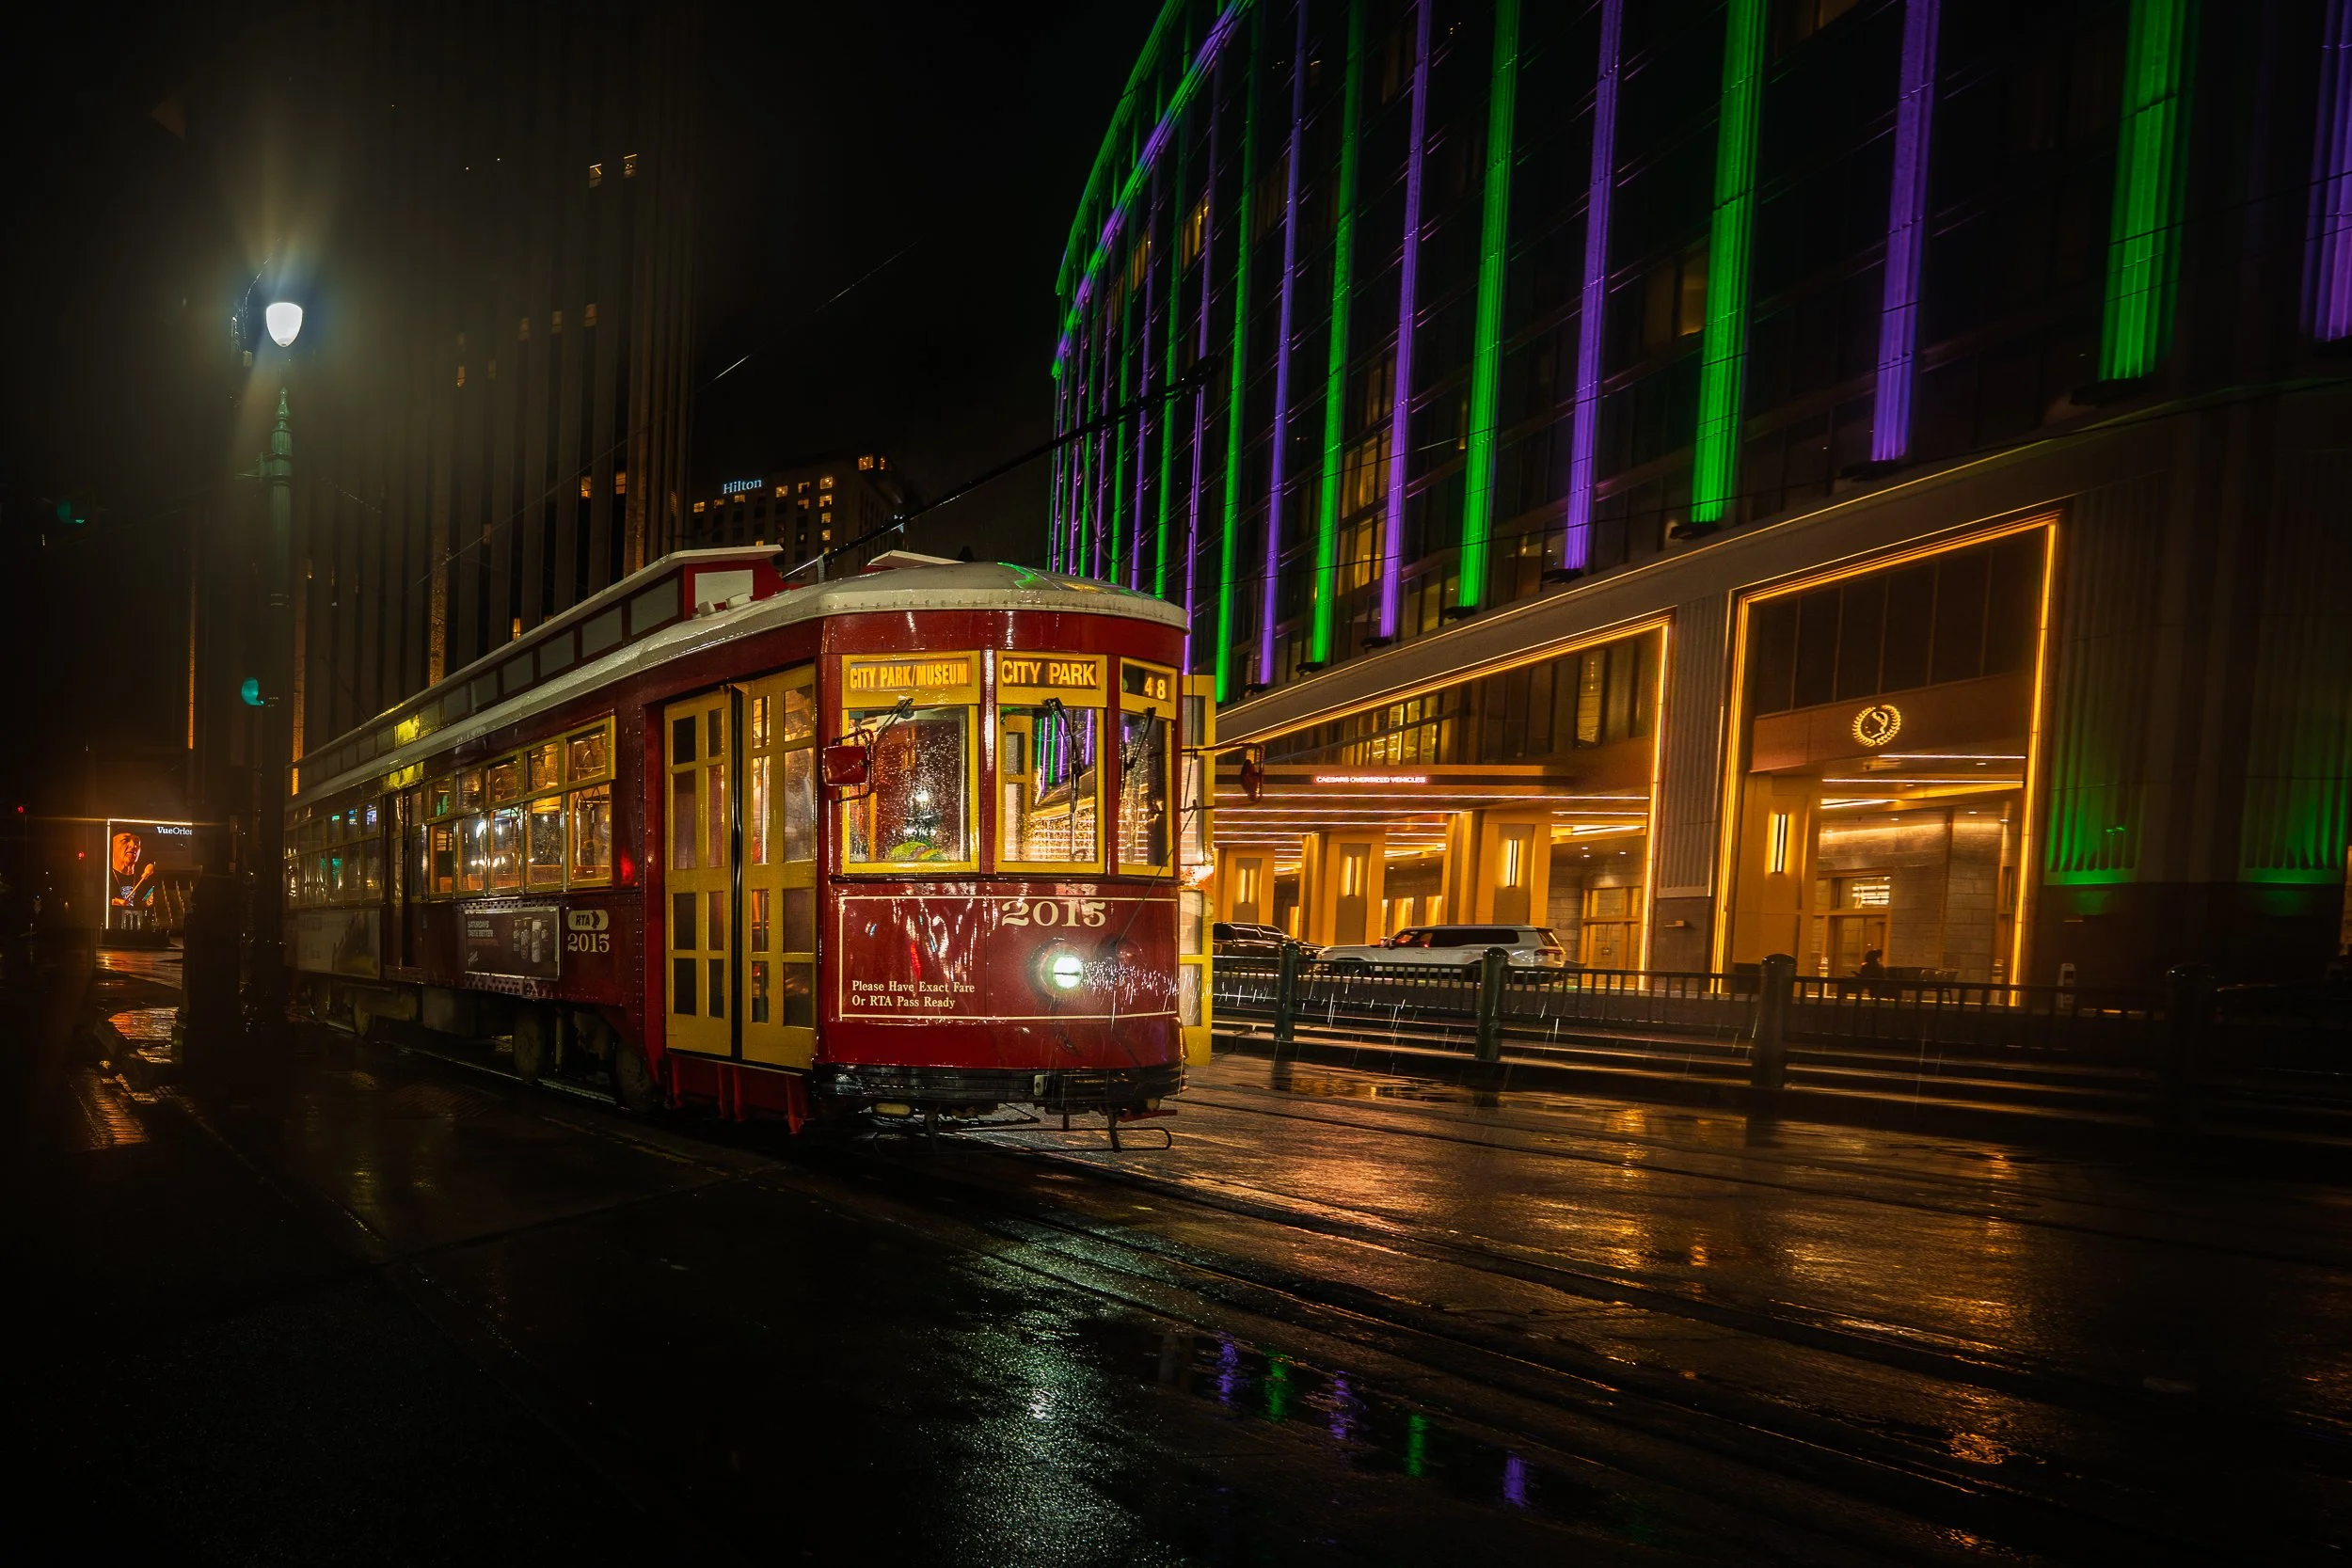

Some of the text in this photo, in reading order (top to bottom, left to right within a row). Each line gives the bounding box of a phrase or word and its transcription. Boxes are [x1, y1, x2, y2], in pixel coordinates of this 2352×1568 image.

[723, 480, 762, 494] Hilton
[850, 664, 967, 689] CITY PARK/MUSEUM
[1001, 660, 1096, 685] CITY PARK
[575, 914, 591, 926] RTA
[1001, 900, 1106, 927] 2015
[567, 932, 610, 953] 2015
[851, 980, 976, 993] Please Have Exact Fare
[851, 995, 956, 1009] Or RTA Pass Ready
